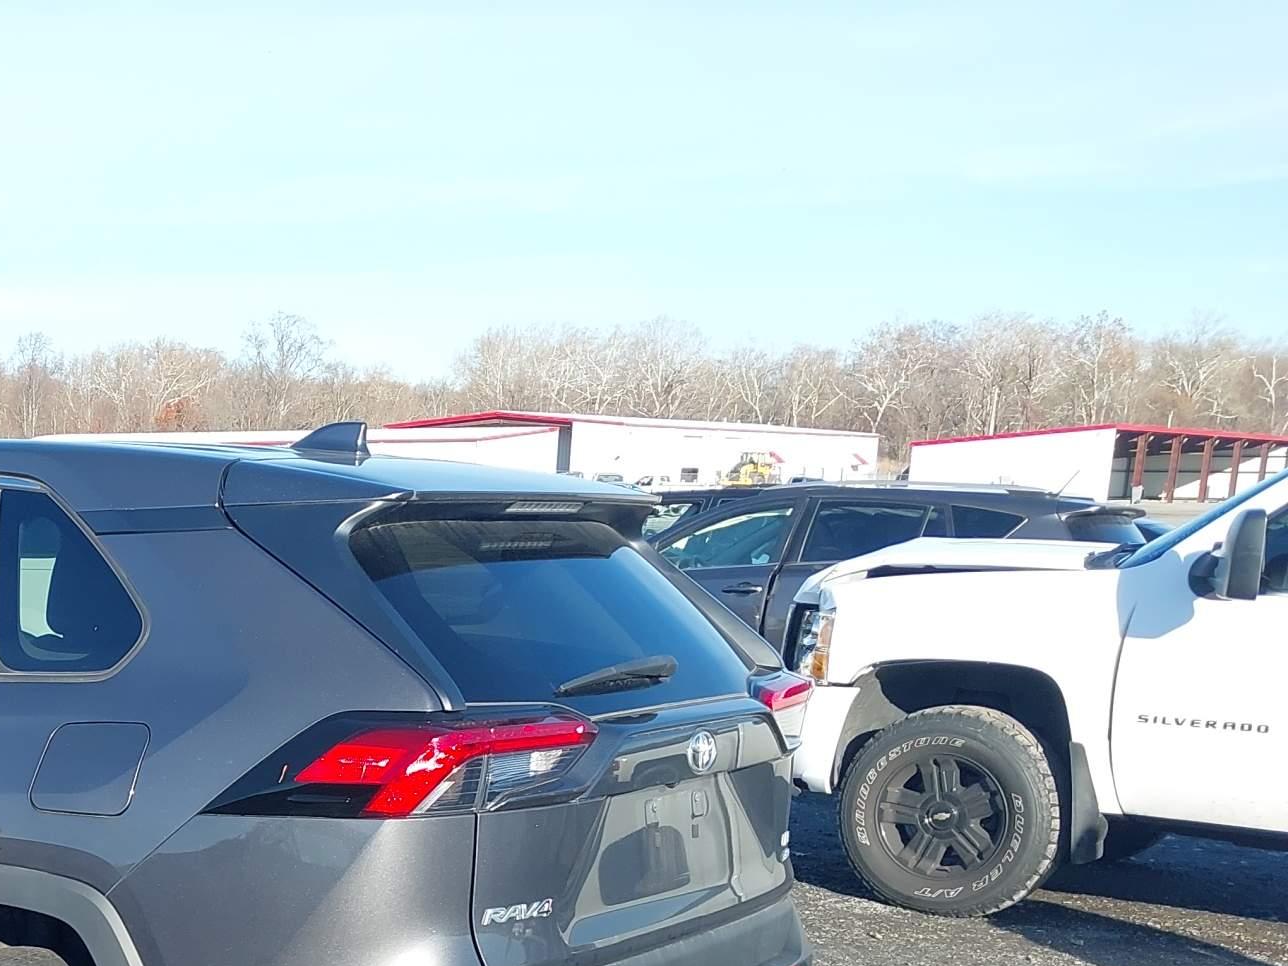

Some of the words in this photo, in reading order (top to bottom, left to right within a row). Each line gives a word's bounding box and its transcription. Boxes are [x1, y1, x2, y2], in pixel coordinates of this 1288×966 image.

[1136, 713, 1270, 735] SILVERADO
[855, 735, 966, 847] BRIDGESTONE
[971, 792, 1025, 892] DUELER
[914, 885, 965, 899] A/T
[480, 898, 553, 926] RAV4
